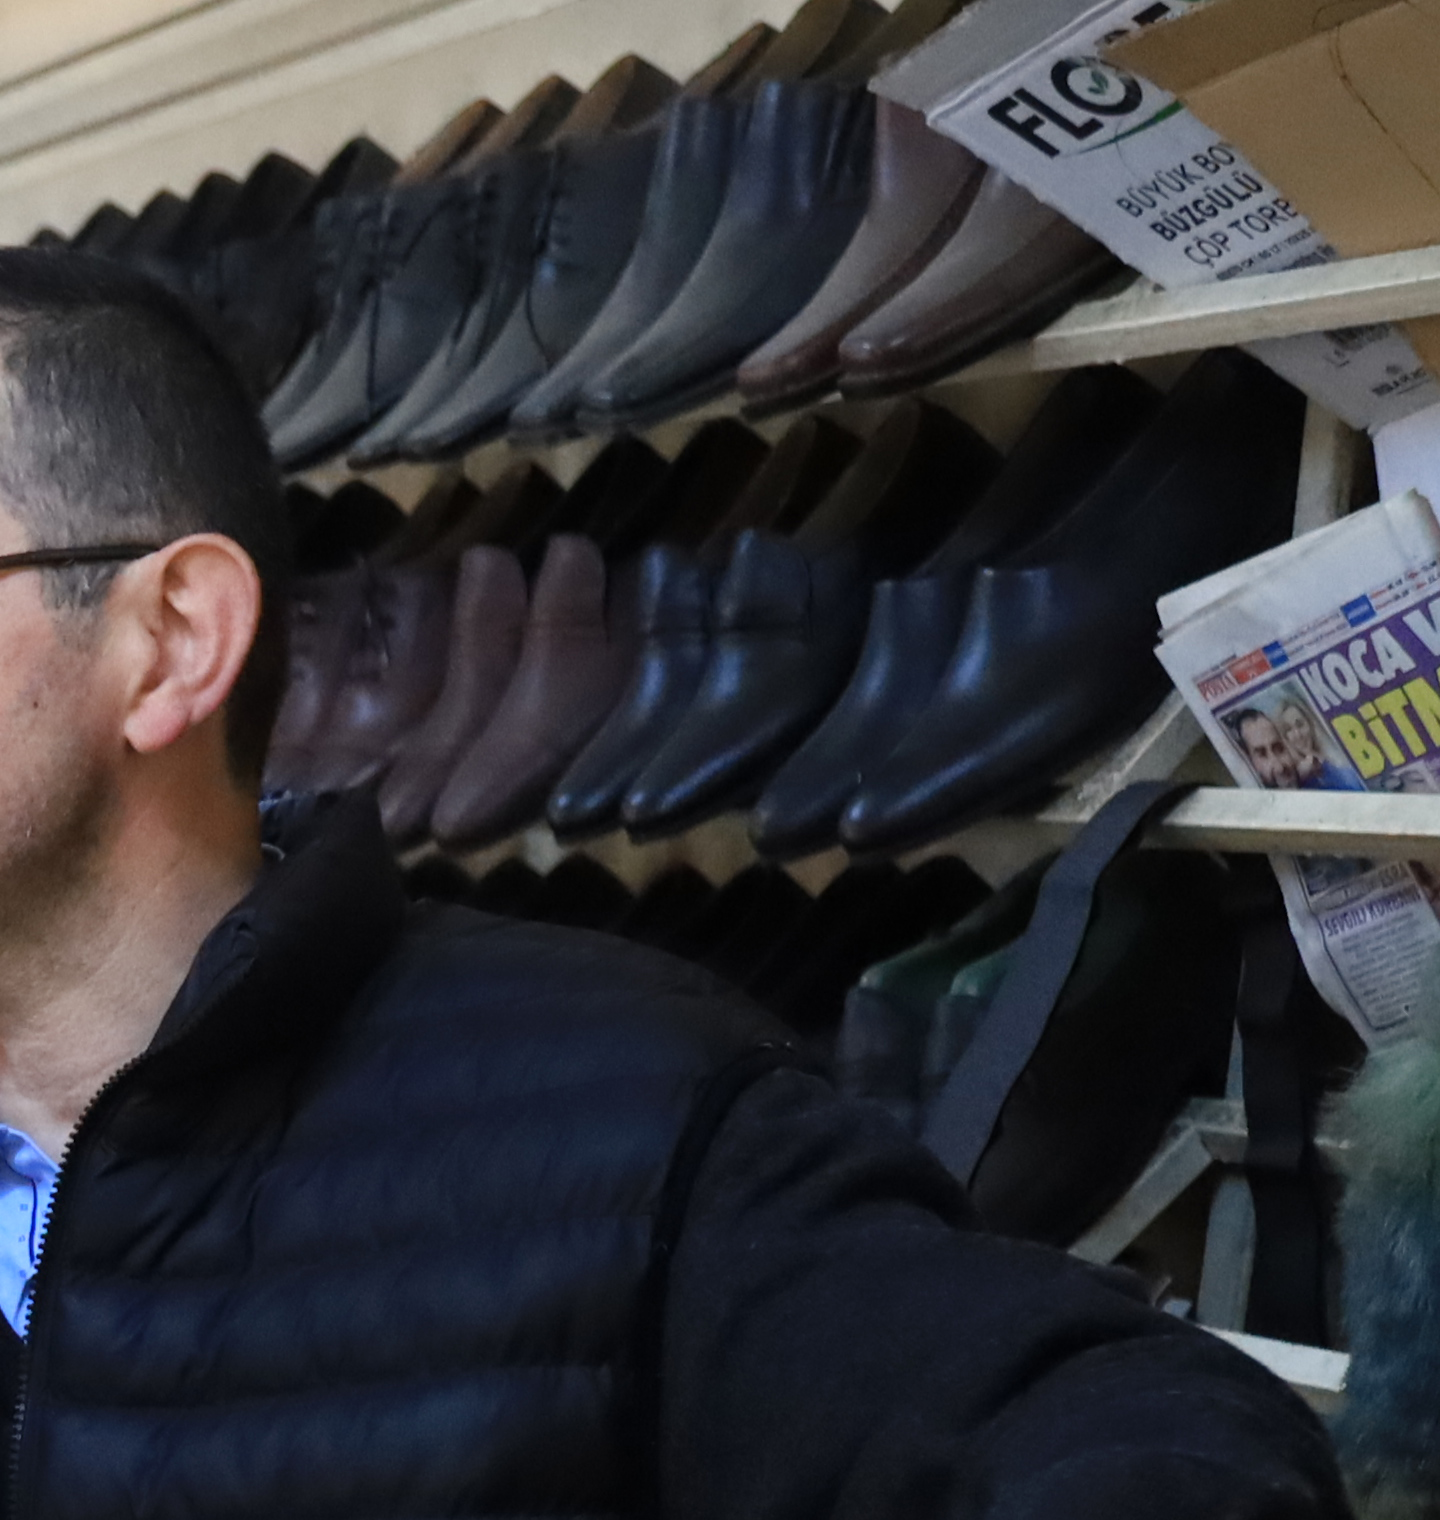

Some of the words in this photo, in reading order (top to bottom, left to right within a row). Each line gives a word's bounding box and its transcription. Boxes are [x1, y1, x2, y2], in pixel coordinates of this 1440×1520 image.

[987, 2, 1170, 158] FLO
[1116, 163, 1205, 218] BÜYÜK
[1192, 142, 1238, 175] BO
[1150, 171, 1263, 242] BÜZGÜLÜ
[1184, 231, 1231, 268] ÇÖP
[1299, 626, 1417, 712] KOCA
